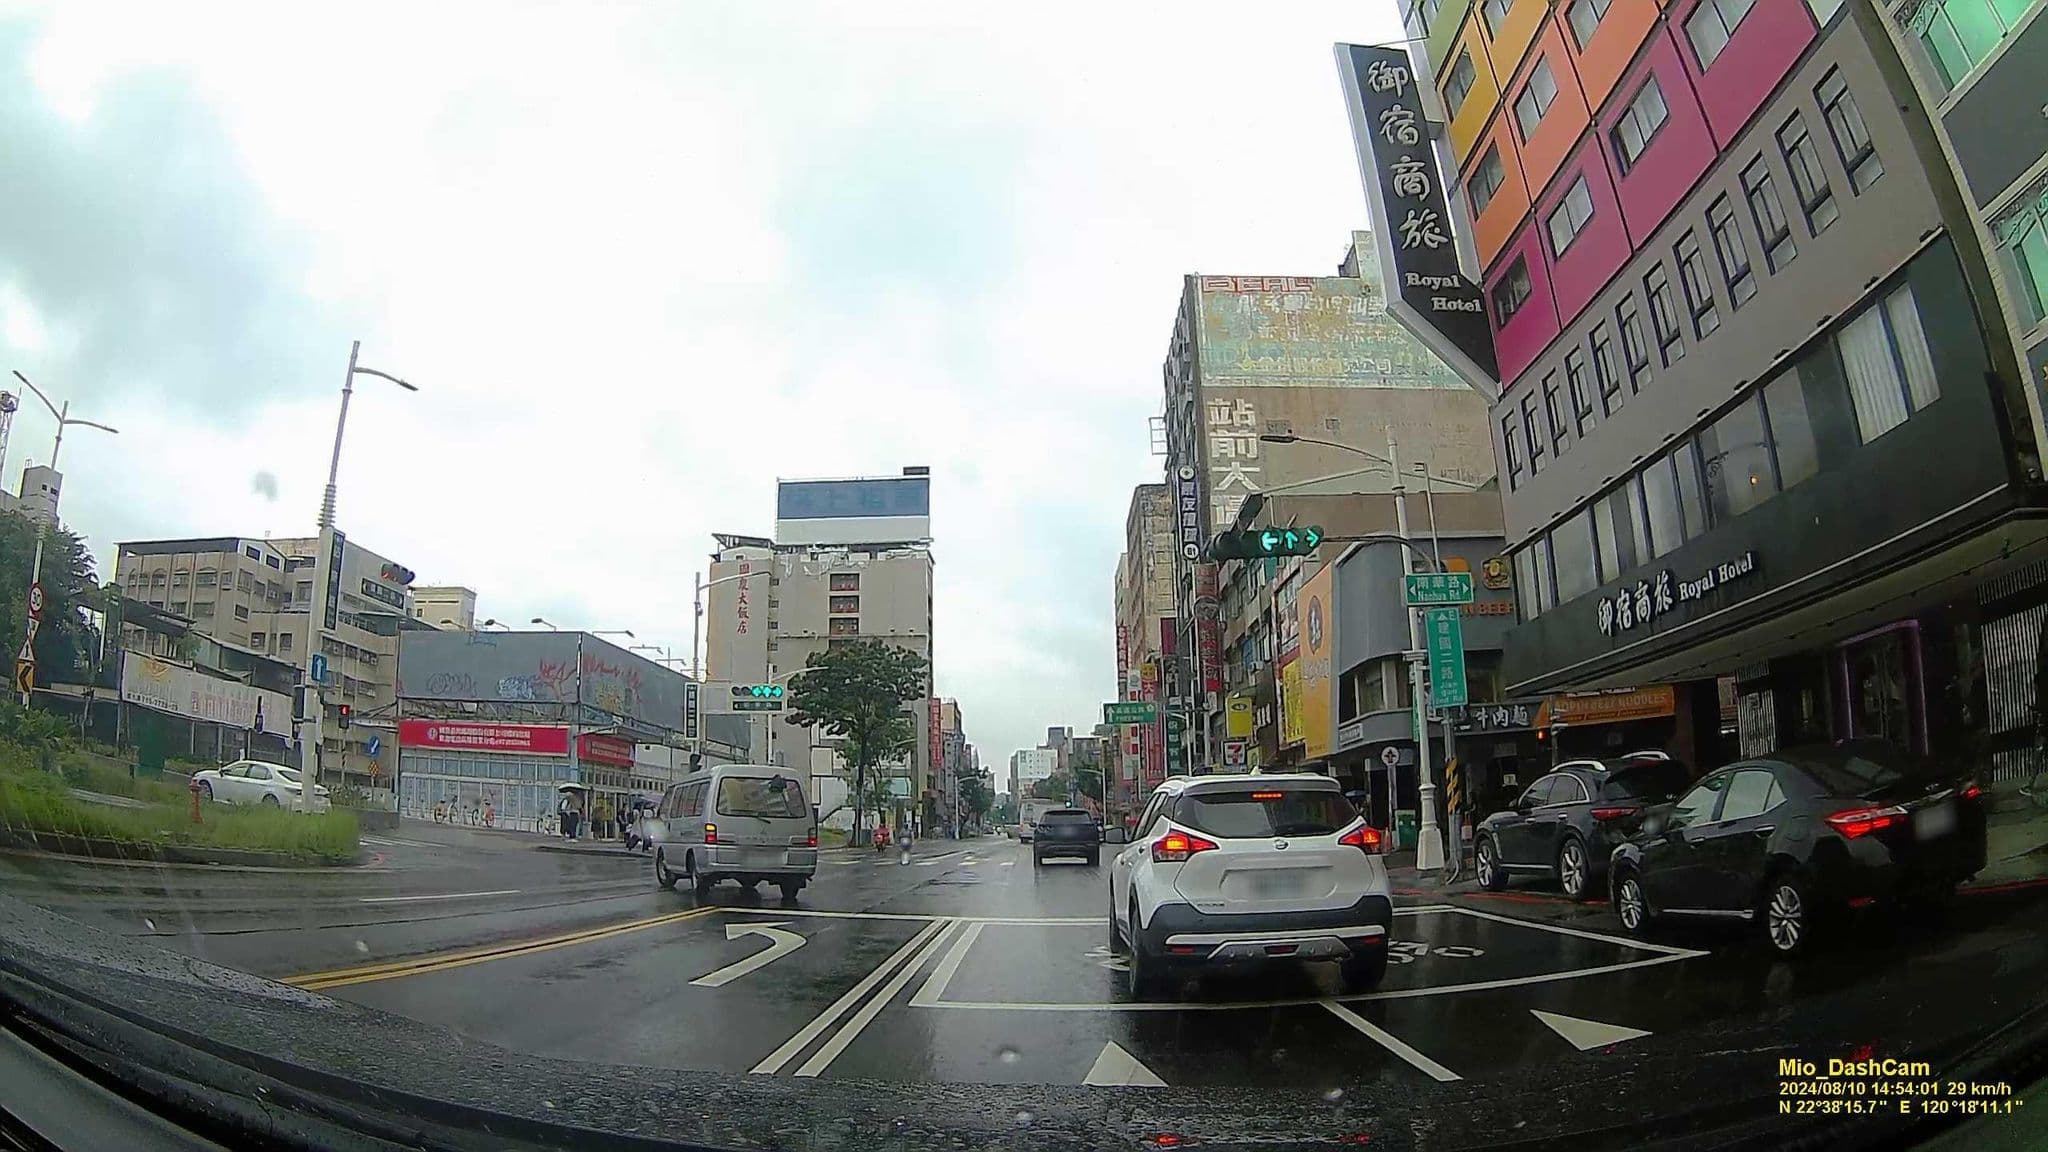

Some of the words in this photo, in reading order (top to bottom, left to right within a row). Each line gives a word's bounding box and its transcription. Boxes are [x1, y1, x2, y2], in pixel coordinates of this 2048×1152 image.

[1368, 60, 1449, 250] 御宿商旅
[1405, 272, 1460, 291] Royal
[1431, 298, 1483, 313] Hotel
[1679, 570, 1715, 600] Royal
[1718, 552, 1753, 583] Hotel
[1598, 570, 1673, 637] 御宿商旅
